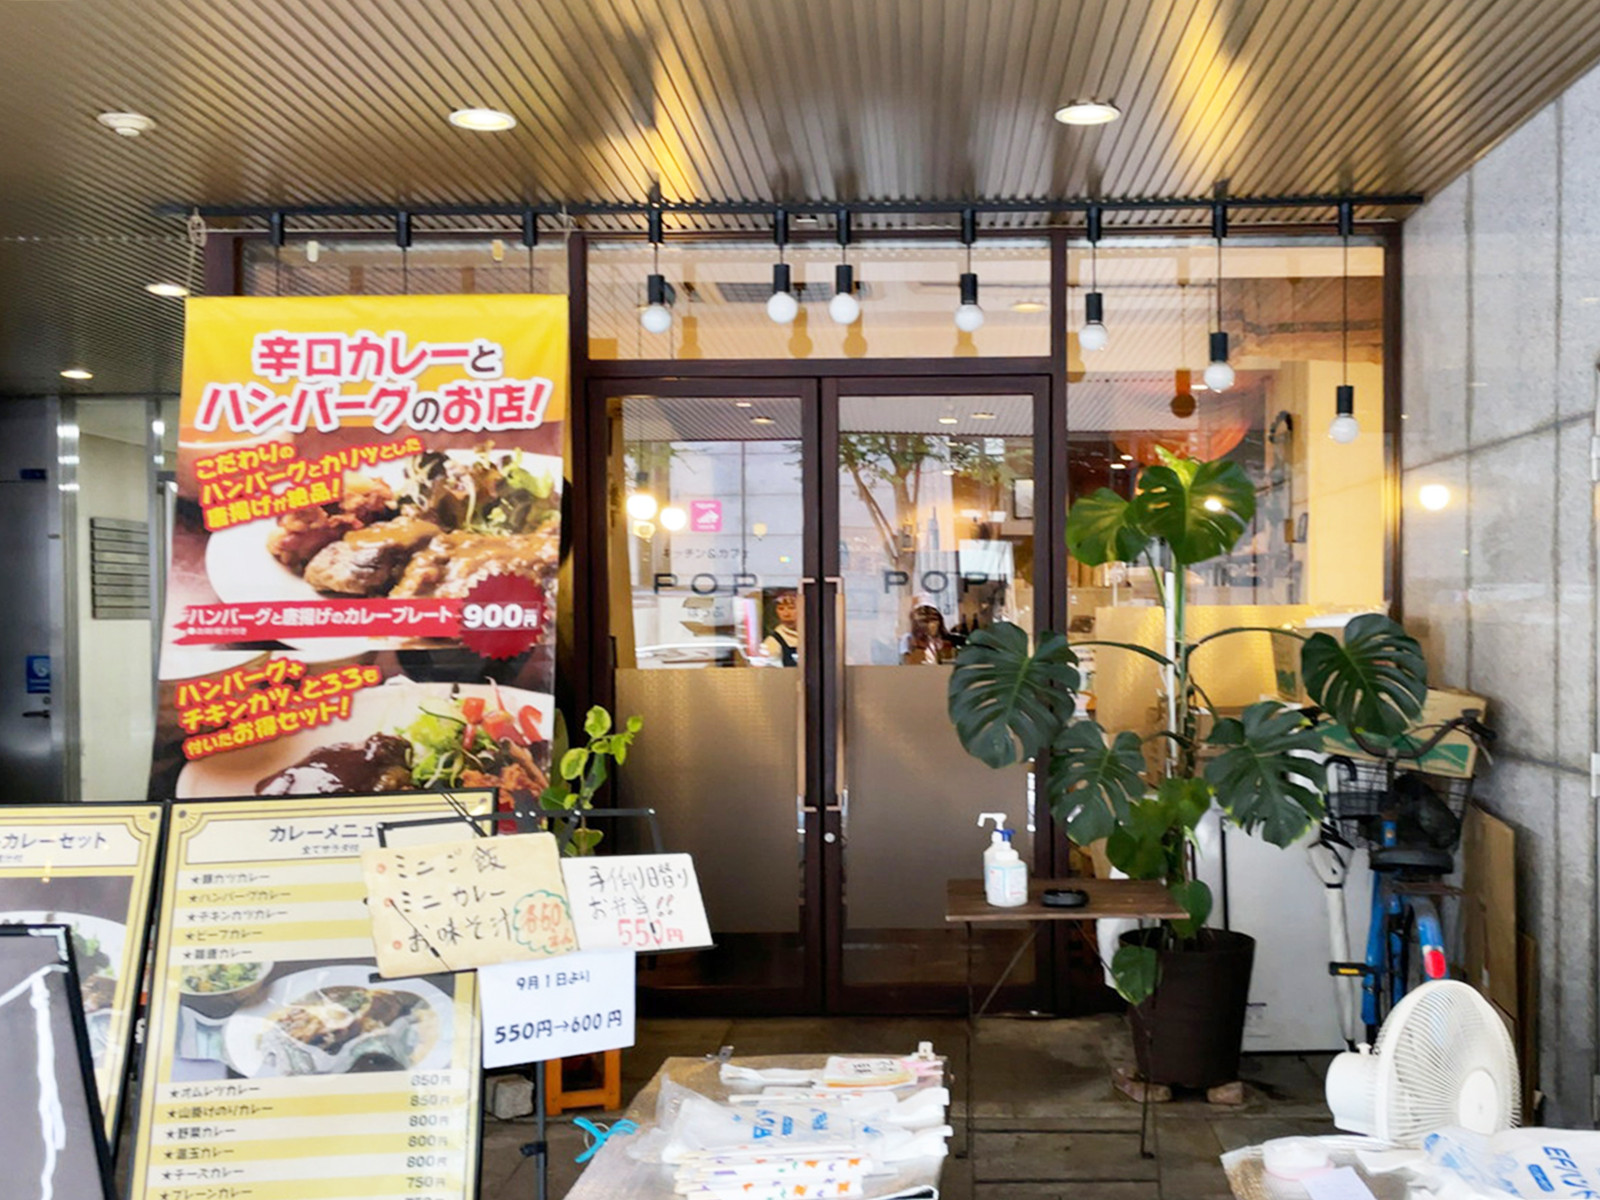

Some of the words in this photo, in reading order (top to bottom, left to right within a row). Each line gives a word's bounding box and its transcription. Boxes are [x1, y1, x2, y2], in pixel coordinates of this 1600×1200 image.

[258, 336, 496, 377] 辛口カレーと
[202, 384, 545, 428] ハンバーグのお店!
[196, 443, 295, 480] こだわりの
[653, 573, 758, 596] POP
[884, 571, 989, 594] POP
[462, 603, 538, 629] 900円
[515, 970, 591, 991] 9月1日より
